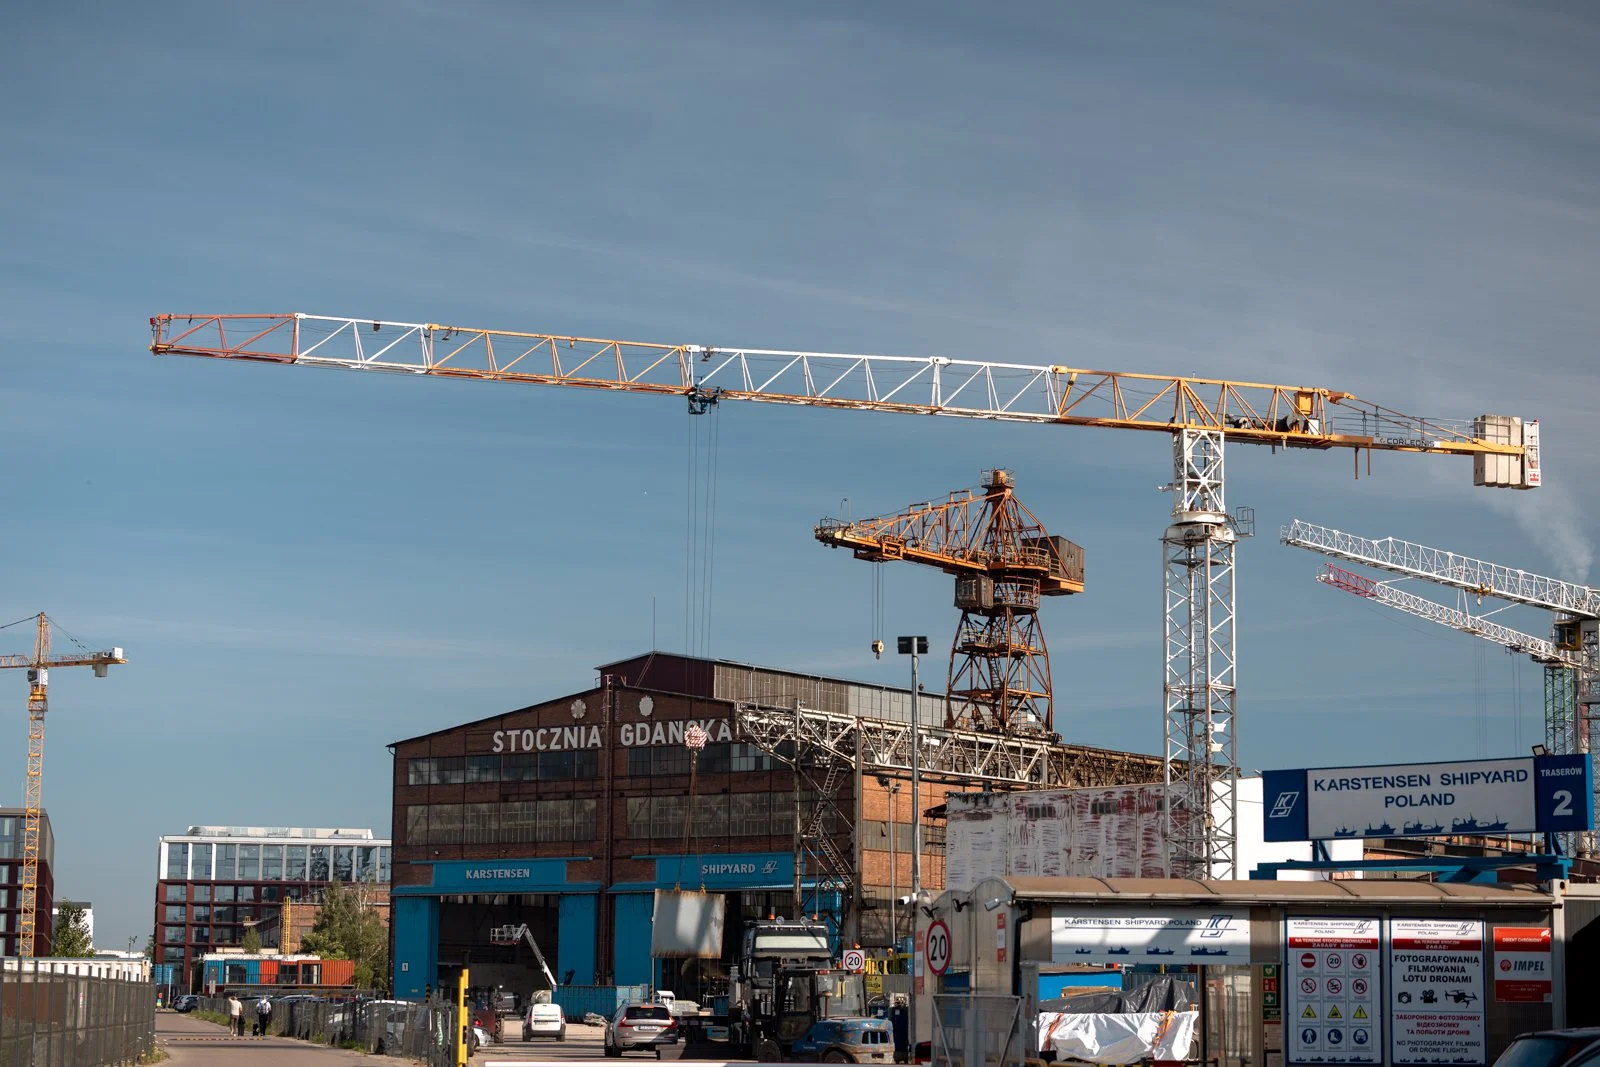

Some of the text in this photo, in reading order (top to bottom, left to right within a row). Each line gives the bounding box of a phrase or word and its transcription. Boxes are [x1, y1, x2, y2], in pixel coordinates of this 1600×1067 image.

[492, 725, 602, 753] STOCZNIA
[1540, 765, 1583, 777] TRASERÓW
[1313, 769, 1529, 792] KARSTENSEN SHIPYARD
[1384, 793, 1455, 808] POLAND
[1552, 789, 1573, 816] 2
[465, 868, 530, 879] KARSTENSEN
[702, 863, 756, 874] SHIPYARD
[930, 934, 947, 961] 20
[847, 956, 860, 966] 20
[1329, 957, 1339, 965] 20
[1394, 954, 1480, 964] FOTOGRAFOWANIA
[1408, 964, 1466, 973] FILMOWANIA
[1513, 960, 1545, 971] IMPEL
[1402, 974, 1472, 983] LOTU DRONAMI
